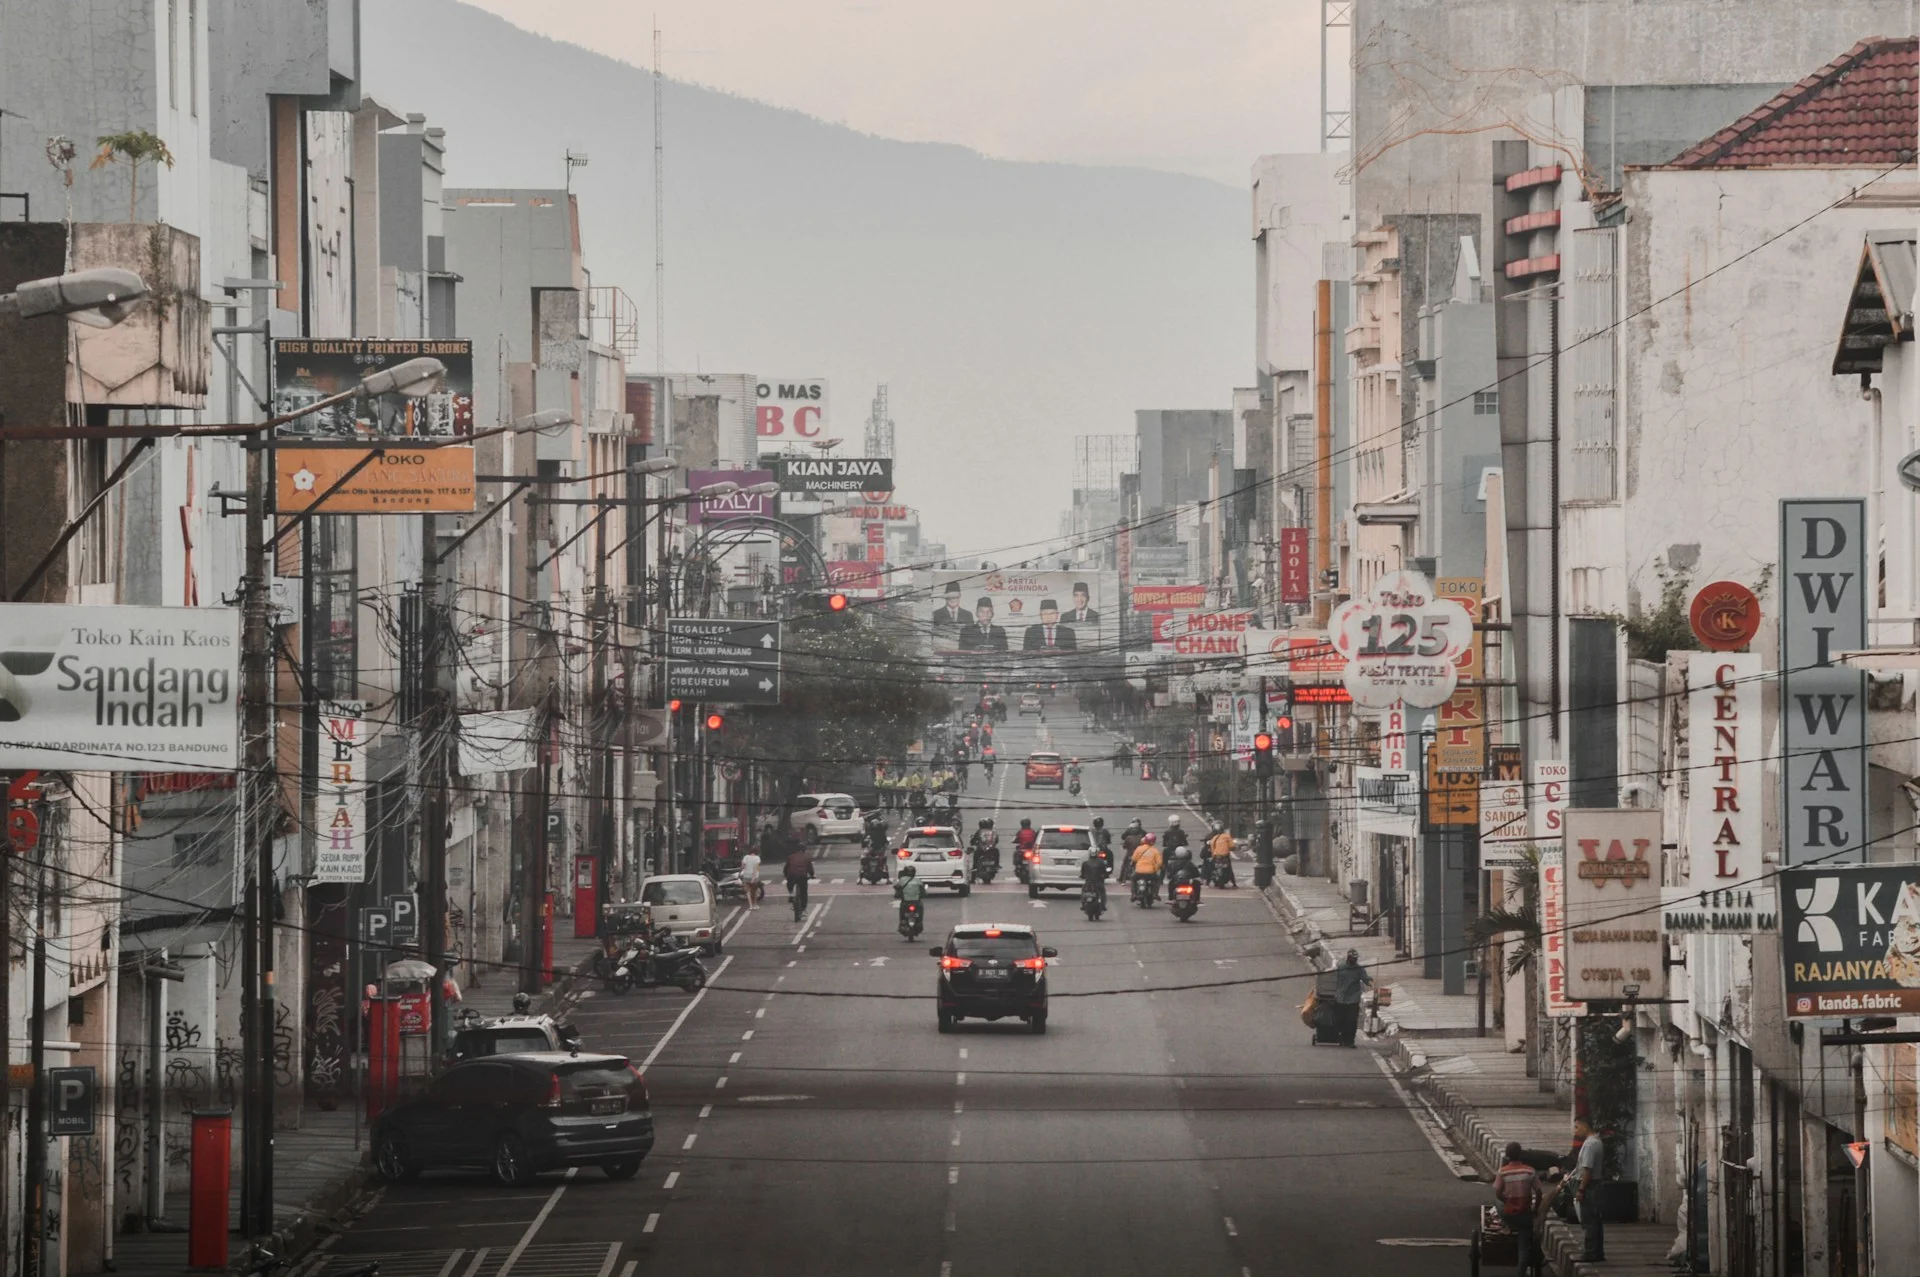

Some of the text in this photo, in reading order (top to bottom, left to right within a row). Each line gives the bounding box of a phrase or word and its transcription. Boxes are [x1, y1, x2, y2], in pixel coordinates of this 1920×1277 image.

[279, 342, 308, 353] HIGH
[313, 342, 362, 354] QUALITY
[367, 342, 418, 354] PRINTED
[778, 384, 822, 400] MAS
[378, 455, 426, 466] TOKO
[787, 461, 884, 476] KIAN JAYA
[805, 480, 864, 491] MACHINERY
[1288, 531, 1300, 593] IDOLA
[1008, 577, 1037, 585] PARTAI
[1439, 582, 1478, 593] TOKO
[71, 627, 231, 648] Toko Kain Kaos
[1357, 613, 1450, 657] 125
[717, 648, 752, 656] PANJANG
[57, 654, 230, 705] Sandang
[670, 678, 730, 687] CIBEUREUM
[670, 688, 707, 697] CIMAHI
[95, 692, 204, 727] Indah
[15, 740, 122, 752] ISKANDARDINATA
[126, 742, 165, 752] NO.123
[168, 743, 229, 753] BANDUNG
[1540, 766, 1567, 776] TOKO
[1712, 663, 1741, 879] CENTRAL
[327, 719, 358, 850] MERIAH
[320, 853, 341, 863] SEDIA
[319, 865, 363, 873] KAIN KAOS
[1700, 890, 1754, 908] SEDIA
[394, 900, 411, 922] P
[370, 913, 388, 936] P
[1793, 960, 1888, 982] RAJANYA
[1818, 994, 1903, 1011] kanda.fabric
[60, 1079, 85, 1111] P
[58, 1116, 86, 1125] MOBIL
